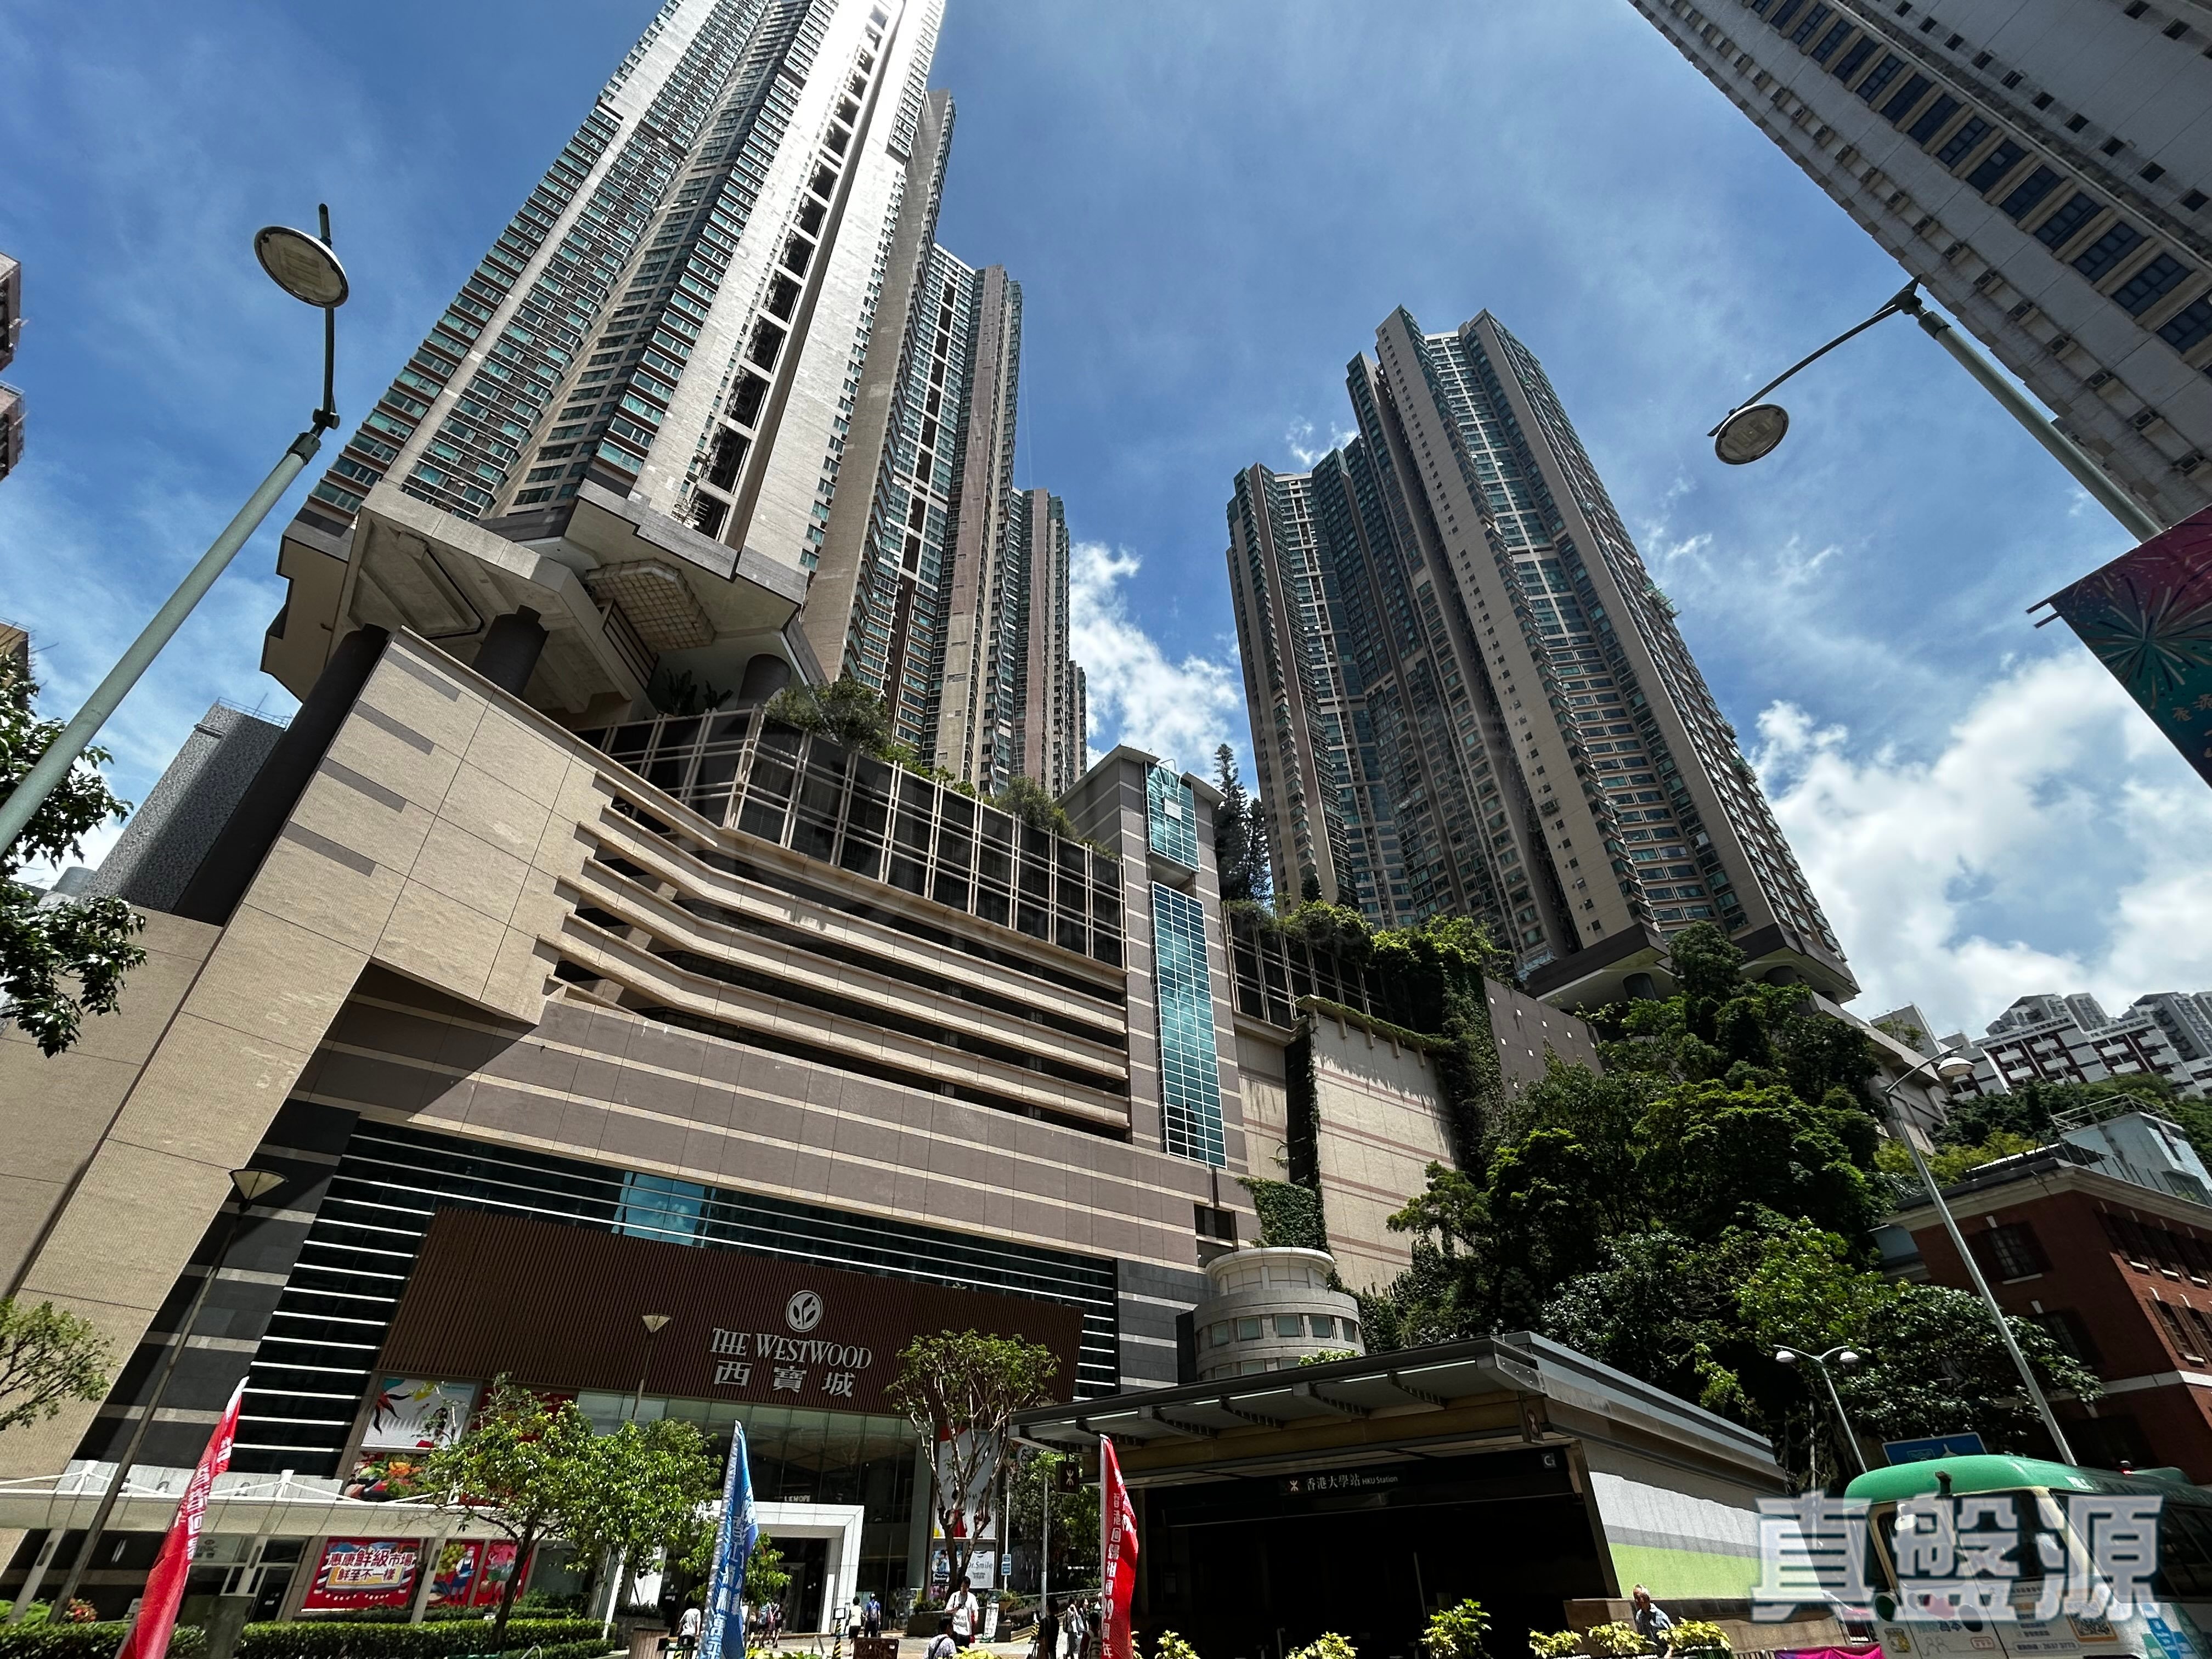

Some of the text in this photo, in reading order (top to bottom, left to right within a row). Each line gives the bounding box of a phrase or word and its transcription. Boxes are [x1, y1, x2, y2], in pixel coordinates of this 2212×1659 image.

[709, 1327, 872, 1369] THE WESTWOOD
[713, 1359, 856, 1398] 西寶城
[1307, 1473, 1398, 1492] 香港大學站 HKU Station
[328, 1549, 415, 1567] 惠康鮮級市場
[337, 1568, 396, 1581] 鮮至不一樣
